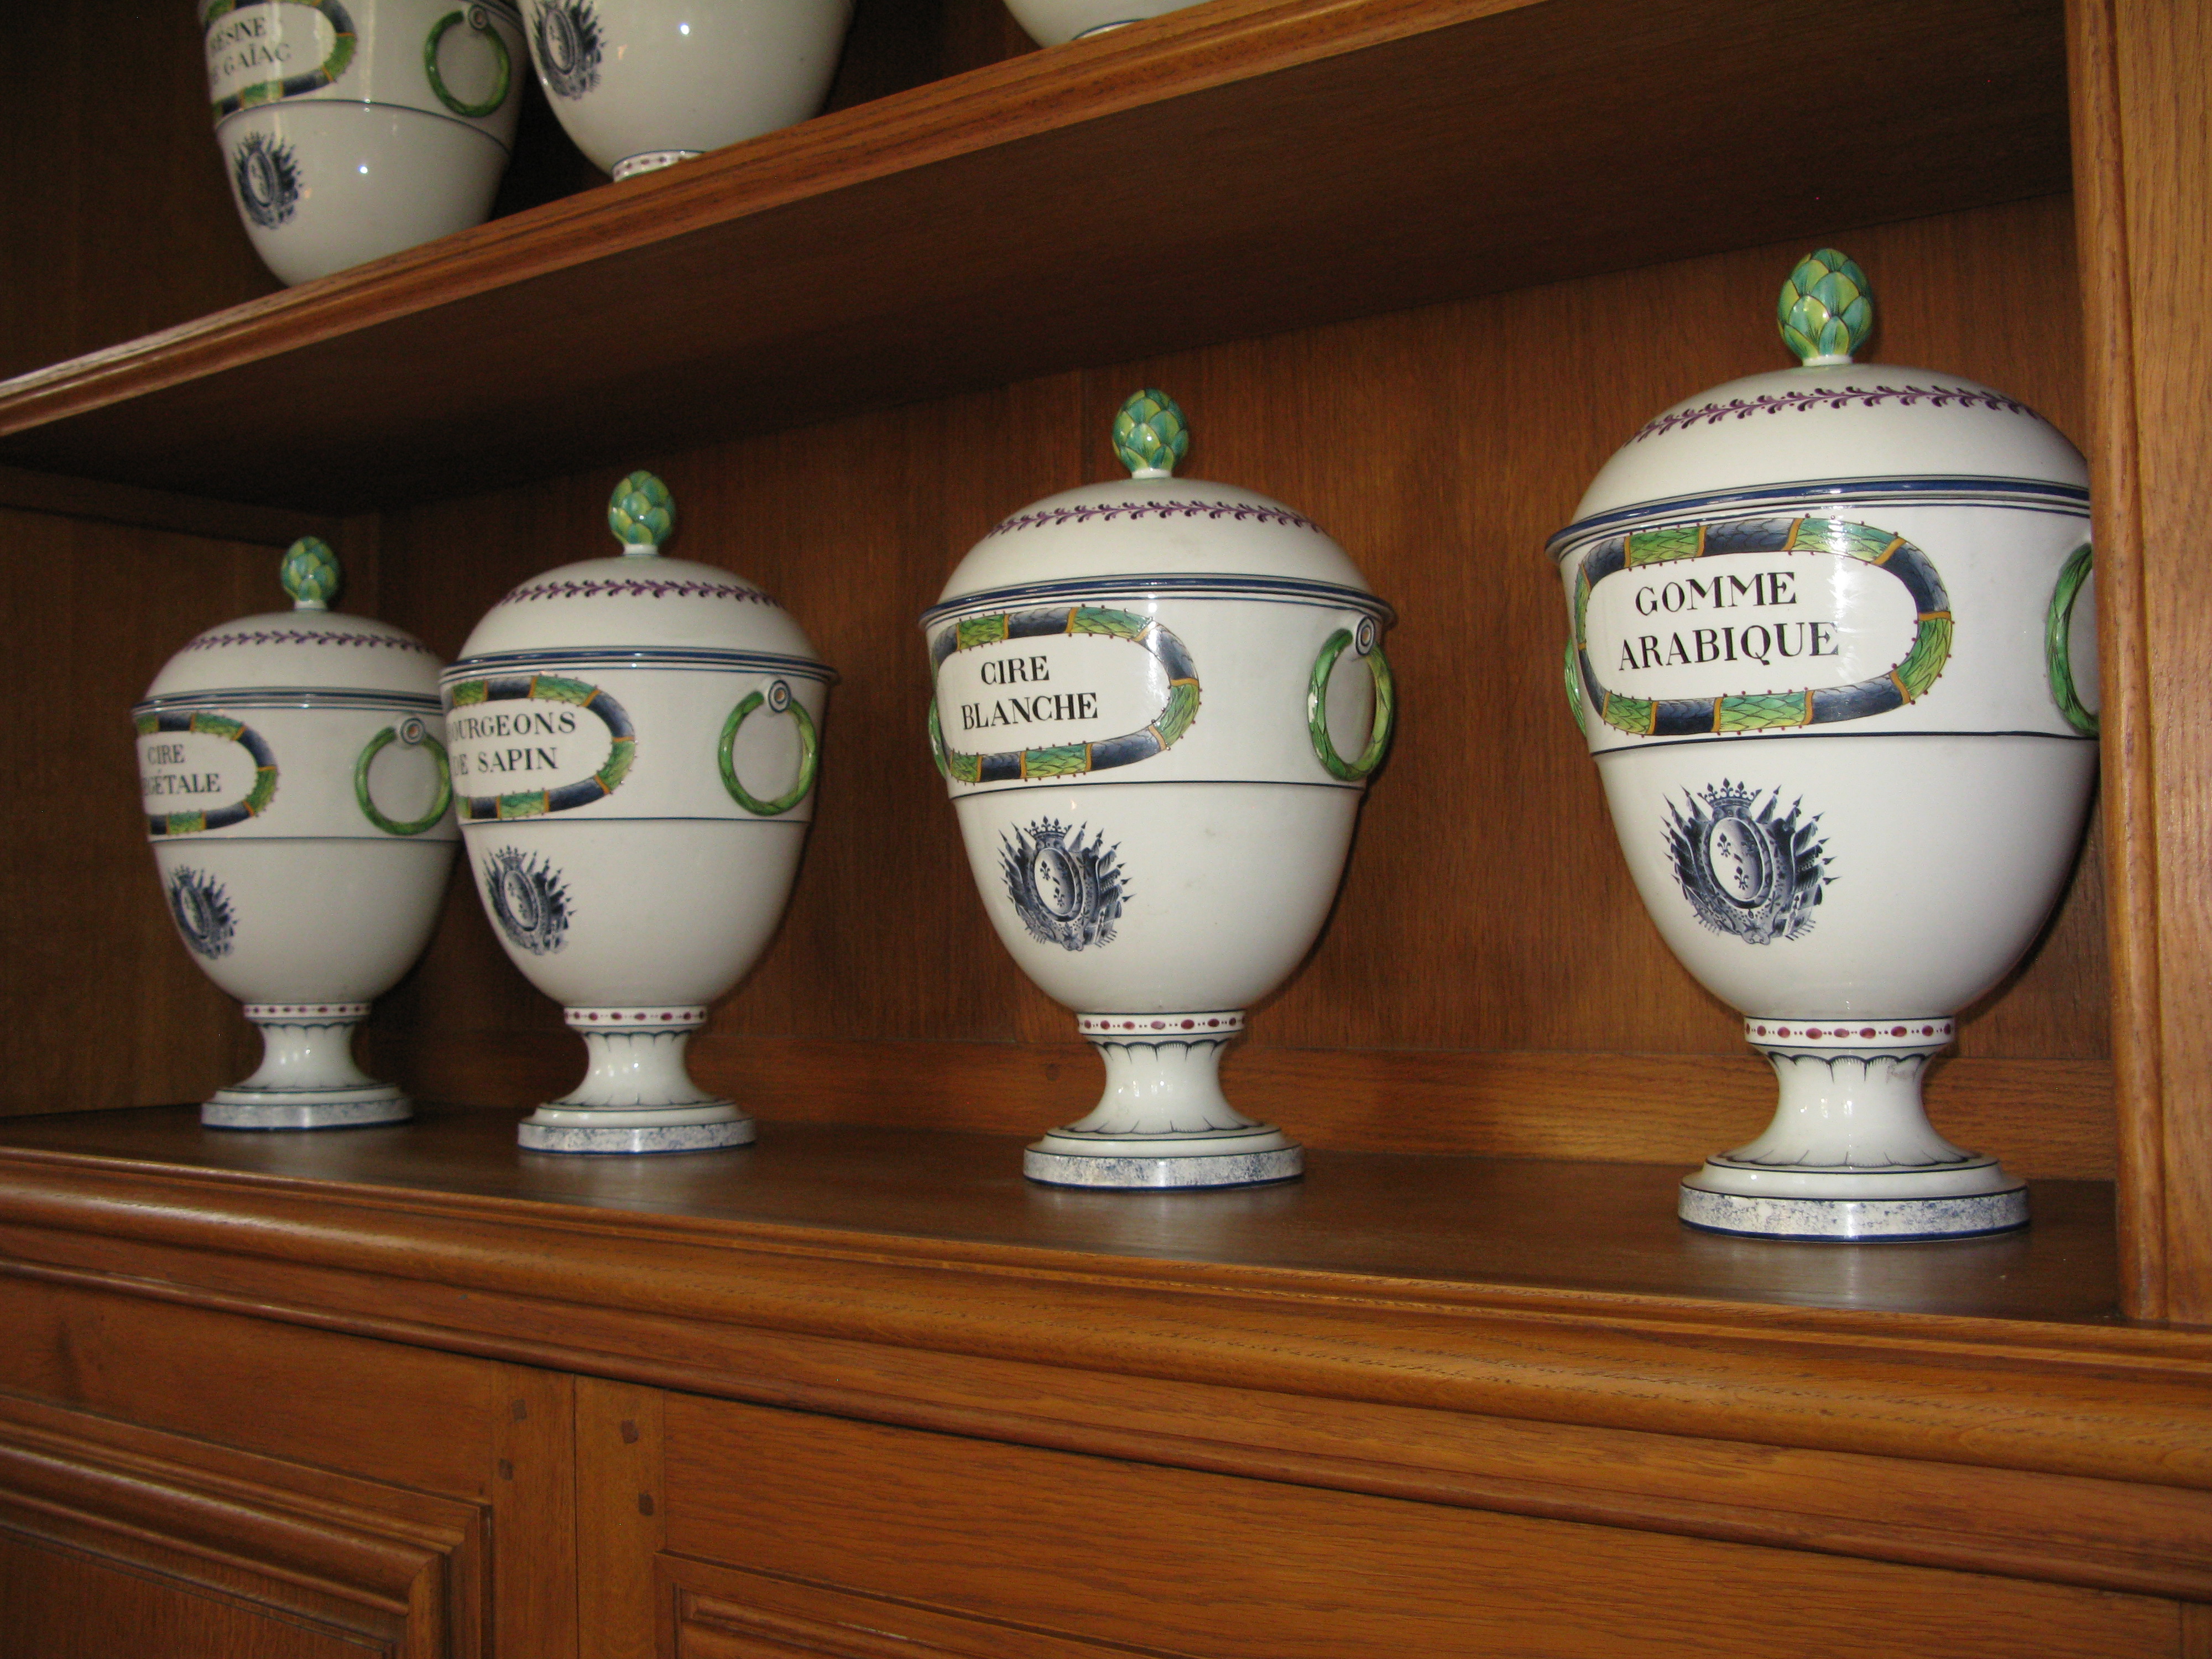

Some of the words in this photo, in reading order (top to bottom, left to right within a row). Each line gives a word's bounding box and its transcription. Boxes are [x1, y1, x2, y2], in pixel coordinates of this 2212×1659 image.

[1635, 571, 1797, 616] GOMME
[1619, 622, 1839, 671] ARABIQUE
[980, 655, 1050, 685] CIRE
[961, 692, 1098, 730] BLANCHE
[148, 744, 185, 765] CIRE
[477, 747, 559, 773] SAPIN
